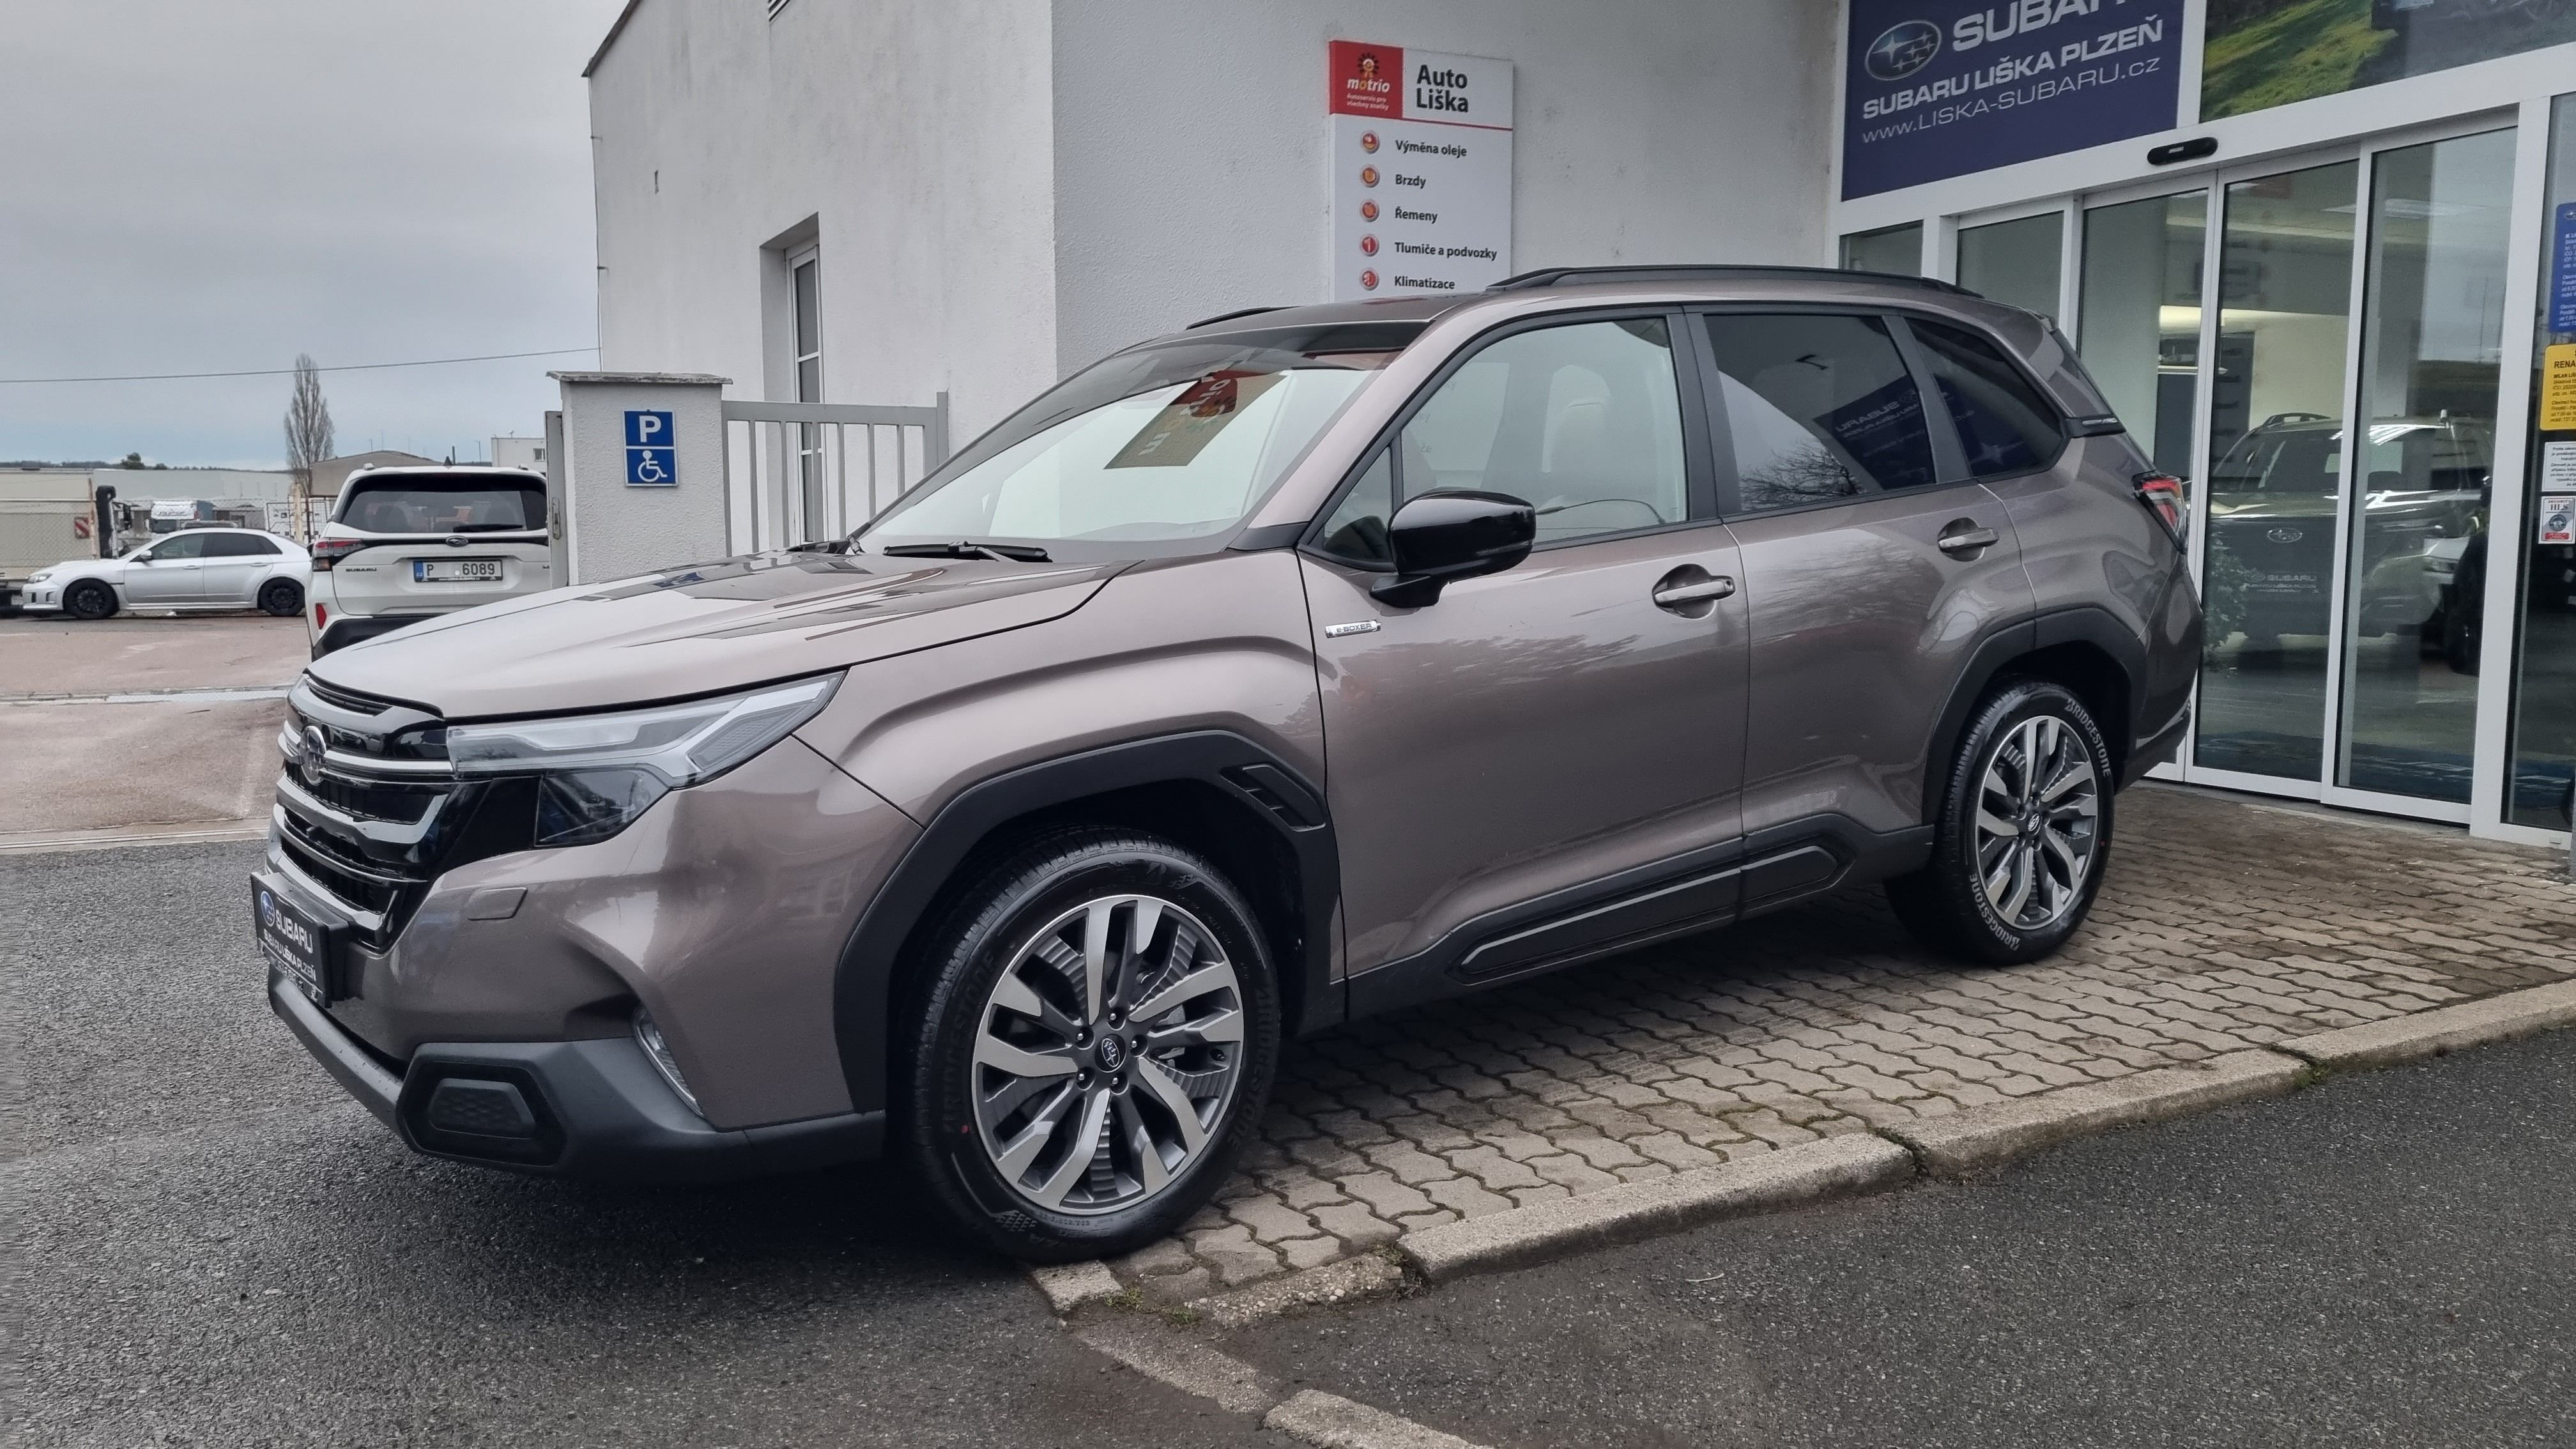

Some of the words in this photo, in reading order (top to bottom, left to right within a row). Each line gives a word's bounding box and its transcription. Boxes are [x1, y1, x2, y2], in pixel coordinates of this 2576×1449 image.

[1952, 0, 2126, 51] SUBA
[1416, 64, 1468, 89] Auto
[1862, 73, 1969, 119] SUBARU
[1974, 56, 2056, 91] LIŠKA
[2060, 13, 2163, 67] PLZEŇ
[1347, 77, 1391, 93] motrio
[1416, 88, 1469, 112] Liška
[1862, 57, 2161, 143] www.LISKA-SUBARU.cz
[1395, 139, 1438, 154] Výměna
[1441, 144, 1467, 158] oleje
[1395, 174, 1427, 189] Brzdy
[1395, 206, 1438, 224] Řemeny
[1394, 241, 1436, 255] Tlumiče
[1438, 247, 1445, 256] a
[1446, 246, 1498, 262] podvozky
[1394, 275, 1455, 289] Klimatizace
[639, 415, 662, 443] P
[427, 564, 434, 576] P
[462, 563, 495, 576] 6089
[1336, 623, 1372, 633] e-BOXER
[2064, 698, 2112, 778] BRIDGESTONE
[1969, 873, 2021, 951] BRIDGESTONE
[275, 908, 314, 954] SUBARU
